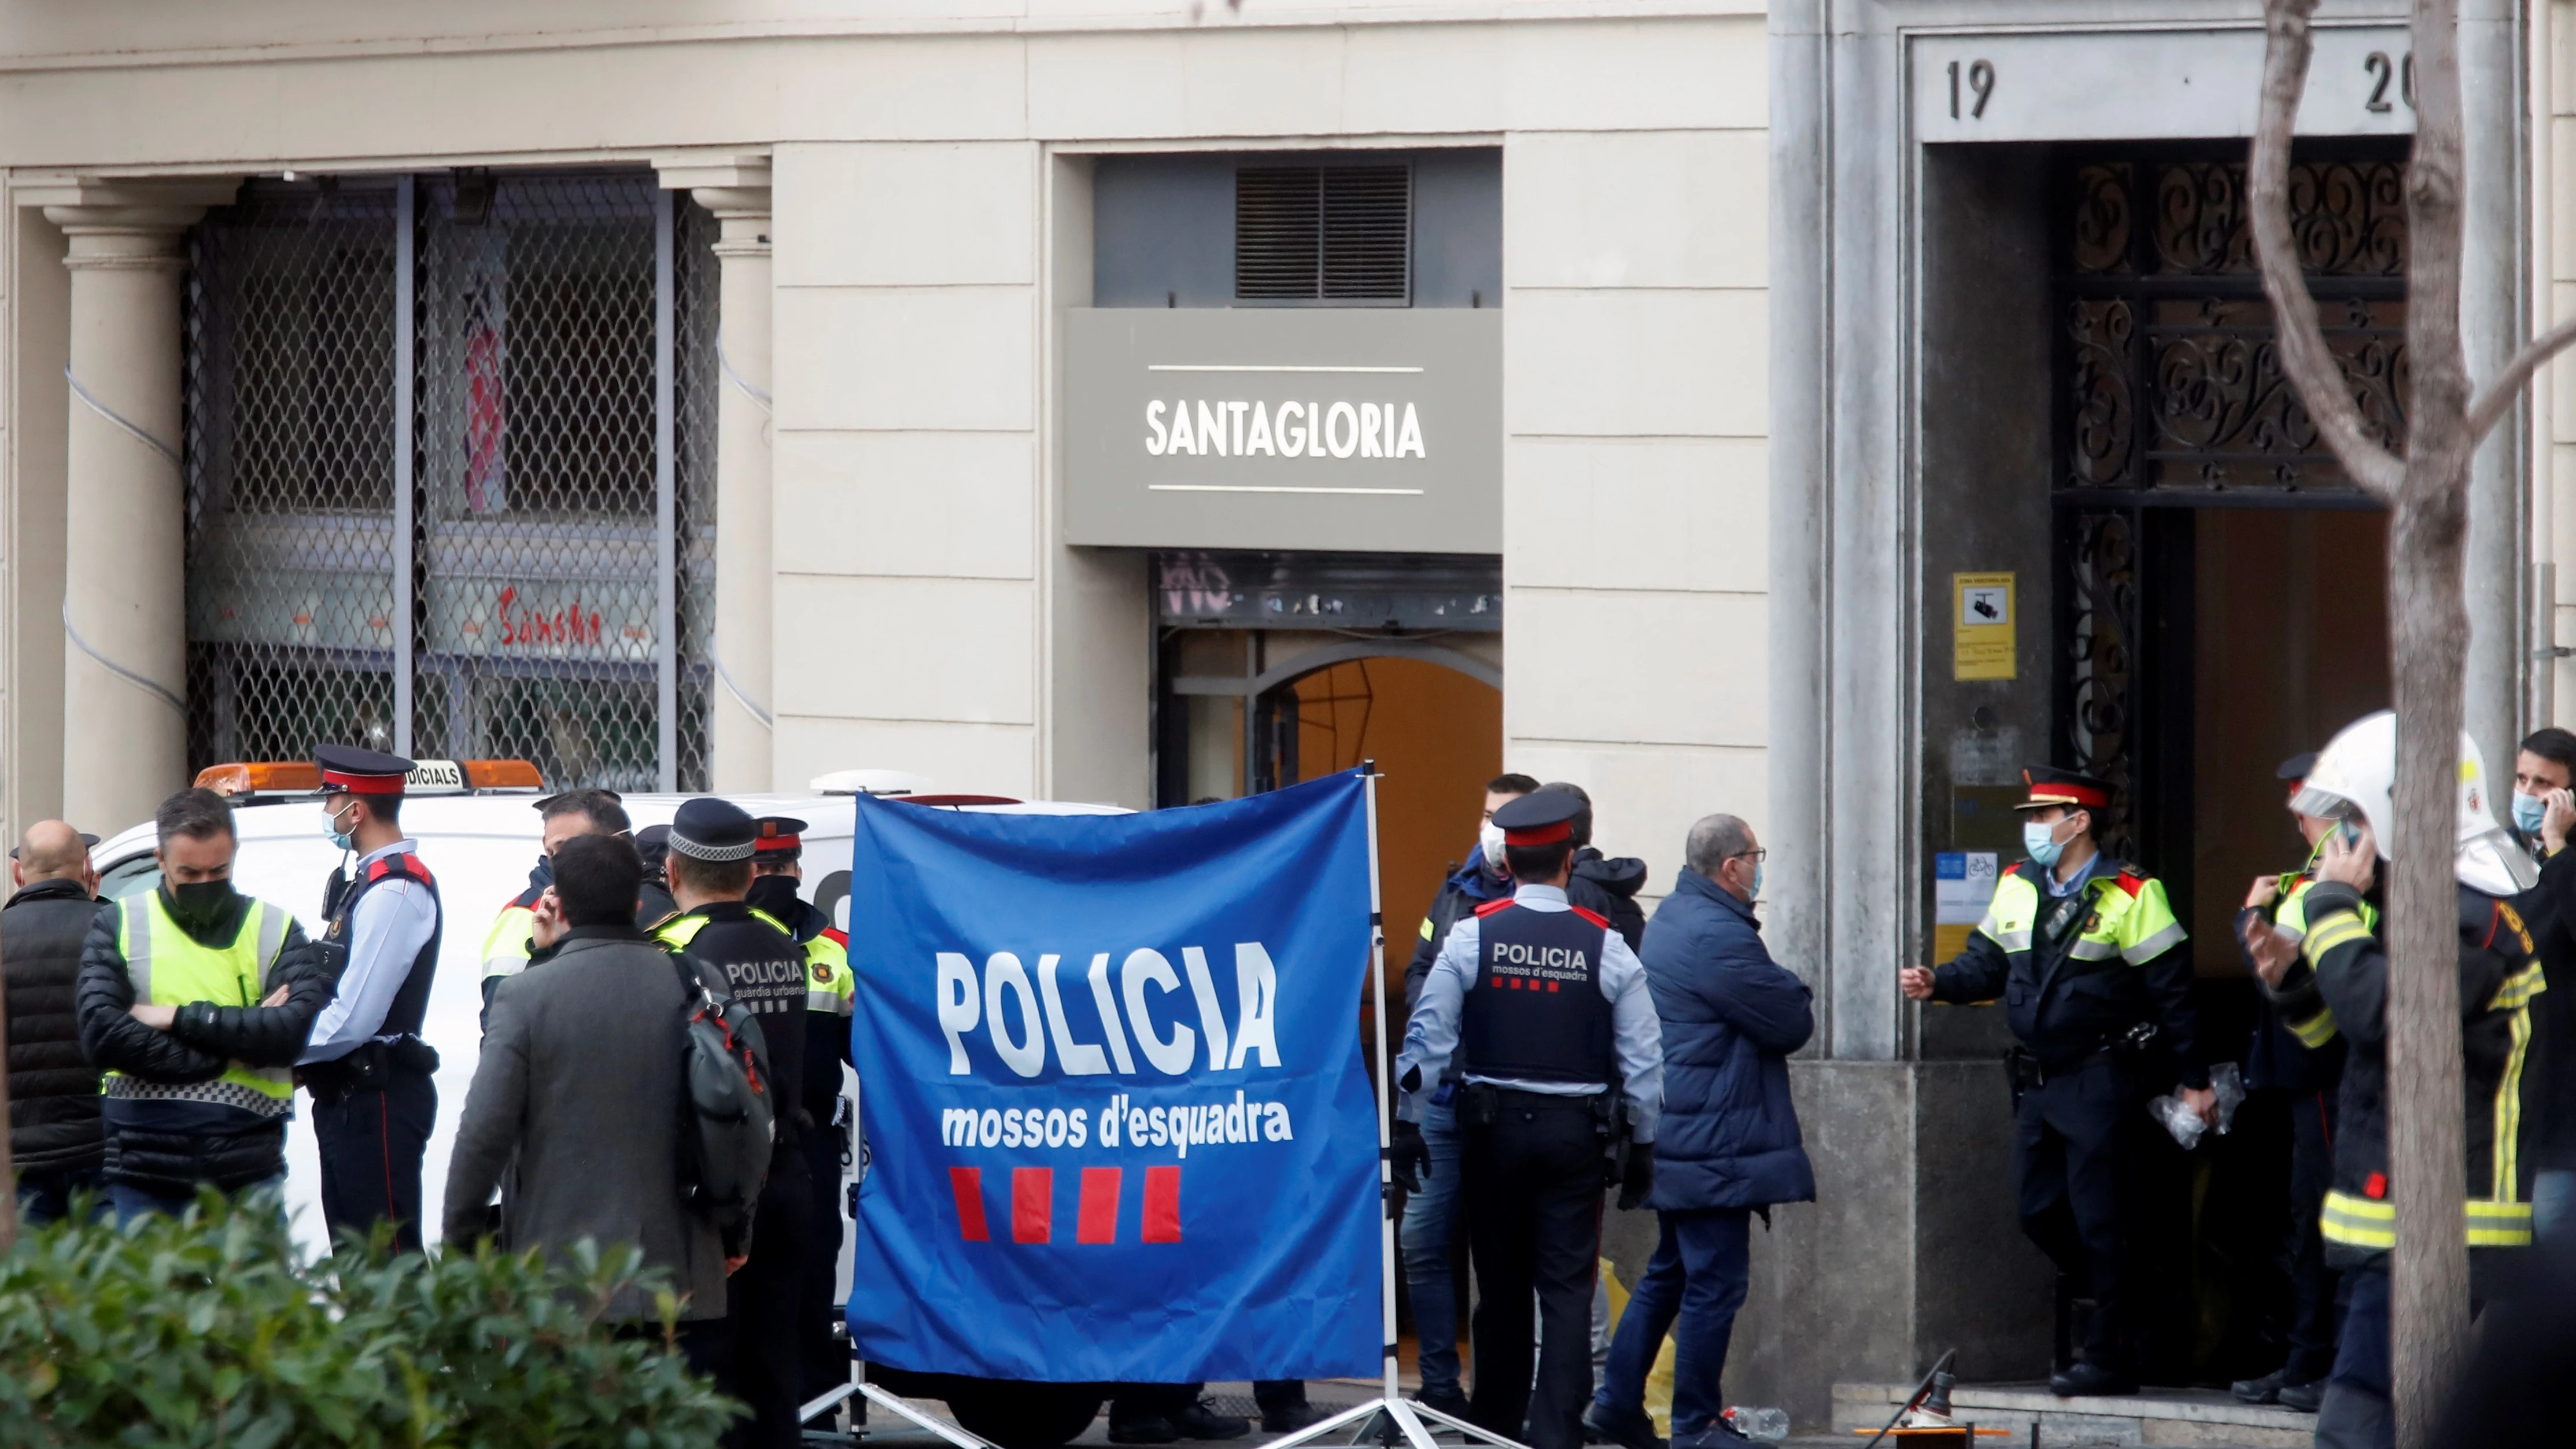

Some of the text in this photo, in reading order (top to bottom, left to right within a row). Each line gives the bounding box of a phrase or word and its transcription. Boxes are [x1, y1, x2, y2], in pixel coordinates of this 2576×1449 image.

[1947, 58, 1995, 120] 19
[1146, 400, 1426, 458] SANTAGLORIA
[405, 768, 459, 784] DICIALS
[1493, 943, 1587, 970] POLICIA
[1493, 965, 1530, 975] mossos
[726, 961, 803, 984] POLICIA
[735, 986, 805, 1000] guàrdia urbana
[936, 941, 1282, 1078] POLICIA
[942, 1089, 1294, 1159] mossos d'esquadra
